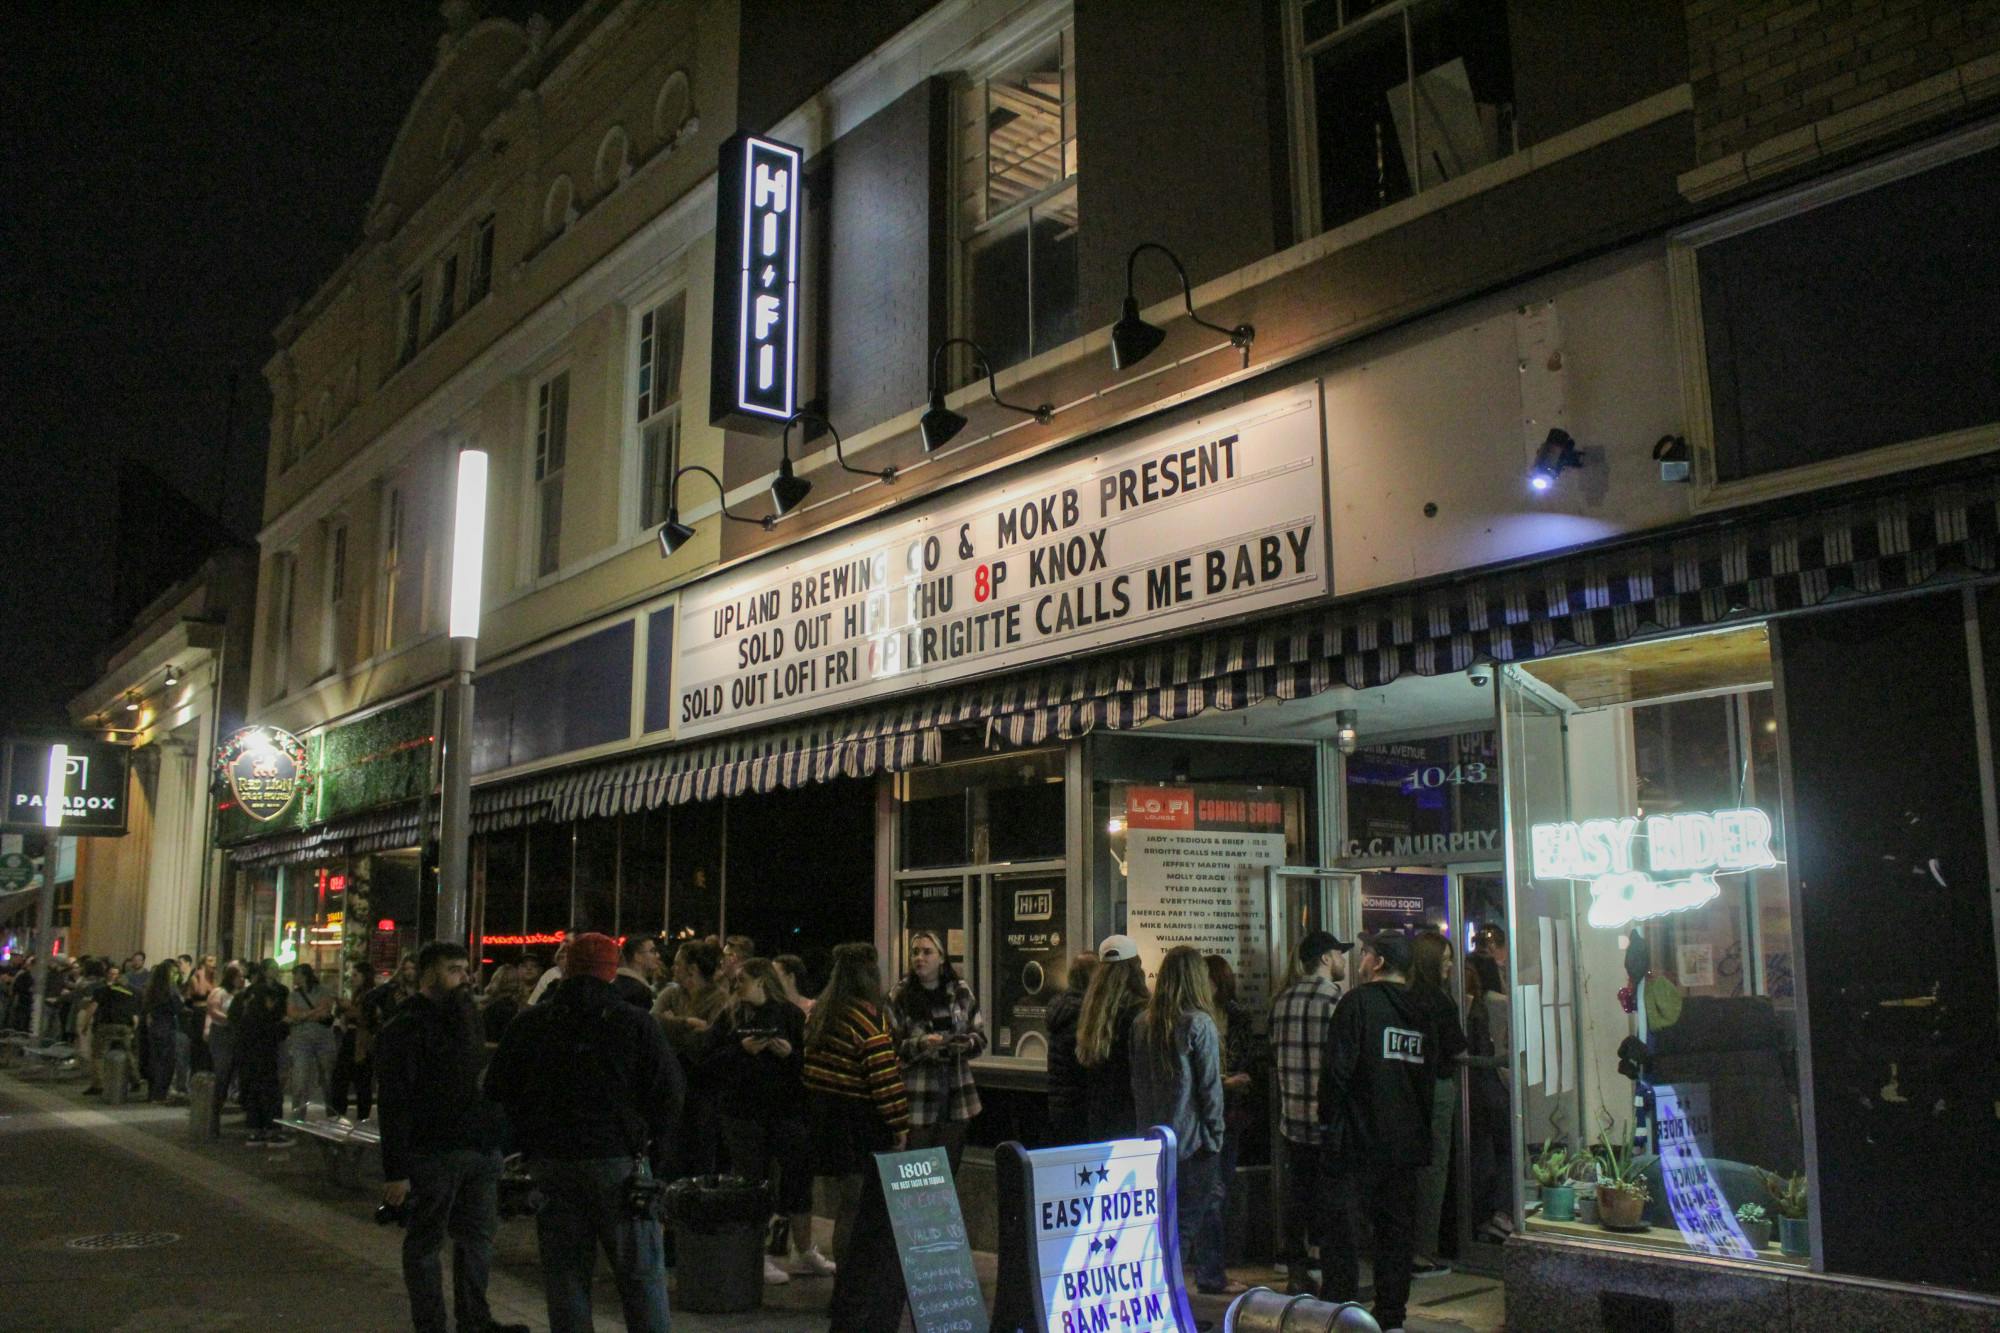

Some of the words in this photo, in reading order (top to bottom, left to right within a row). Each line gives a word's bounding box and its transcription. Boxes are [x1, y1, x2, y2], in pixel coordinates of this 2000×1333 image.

[714, 589, 780, 639] UPLAND
[792, 551, 884, 613] BREWING
[907, 535, 941, 575] CO
[958, 522, 974, 561] &
[998, 488, 1079, 549] MOKB
[1100, 434, 1239, 518] PRESENT
[738, 627, 784, 670] SOLD
[794, 612, 832, 652] OUT
[974, 560, 1007, 603] 8P
[1030, 528, 1107, 588] KNOX
[682, 684, 723, 723] SOLD
[732, 672, 767, 710] OUT
[774, 658, 816, 700] LOFI
[825, 647, 857, 689] FRI
[907, 603, 1021, 669] BRIGITTE
[1036, 575, 1130, 636] CALLS
[1147, 558, 1193, 611] ME
[1206, 526, 1312, 595] BABY
[1408, 762, 1487, 789] 1043
[16, 794, 115, 810] PAADOX
[1198, 800, 1246, 822] COMING
[1394, 829, 1498, 856] MURPHY
[1533, 818, 1637, 878] EASY
[1648, 808, 1775, 870] RIDER
[1363, 899, 1397, 908] COMING
[1398, 900, 1421, 909] SOON
[898, 1161, 932, 1179] 1800
[1042, 1196, 1094, 1231] EASY
[1101, 1188, 1156, 1222] RIDER
[1063, 1260, 1144, 1301] BRUNCH
[1062, 1294, 1164, 1333] 8AM-4PM
